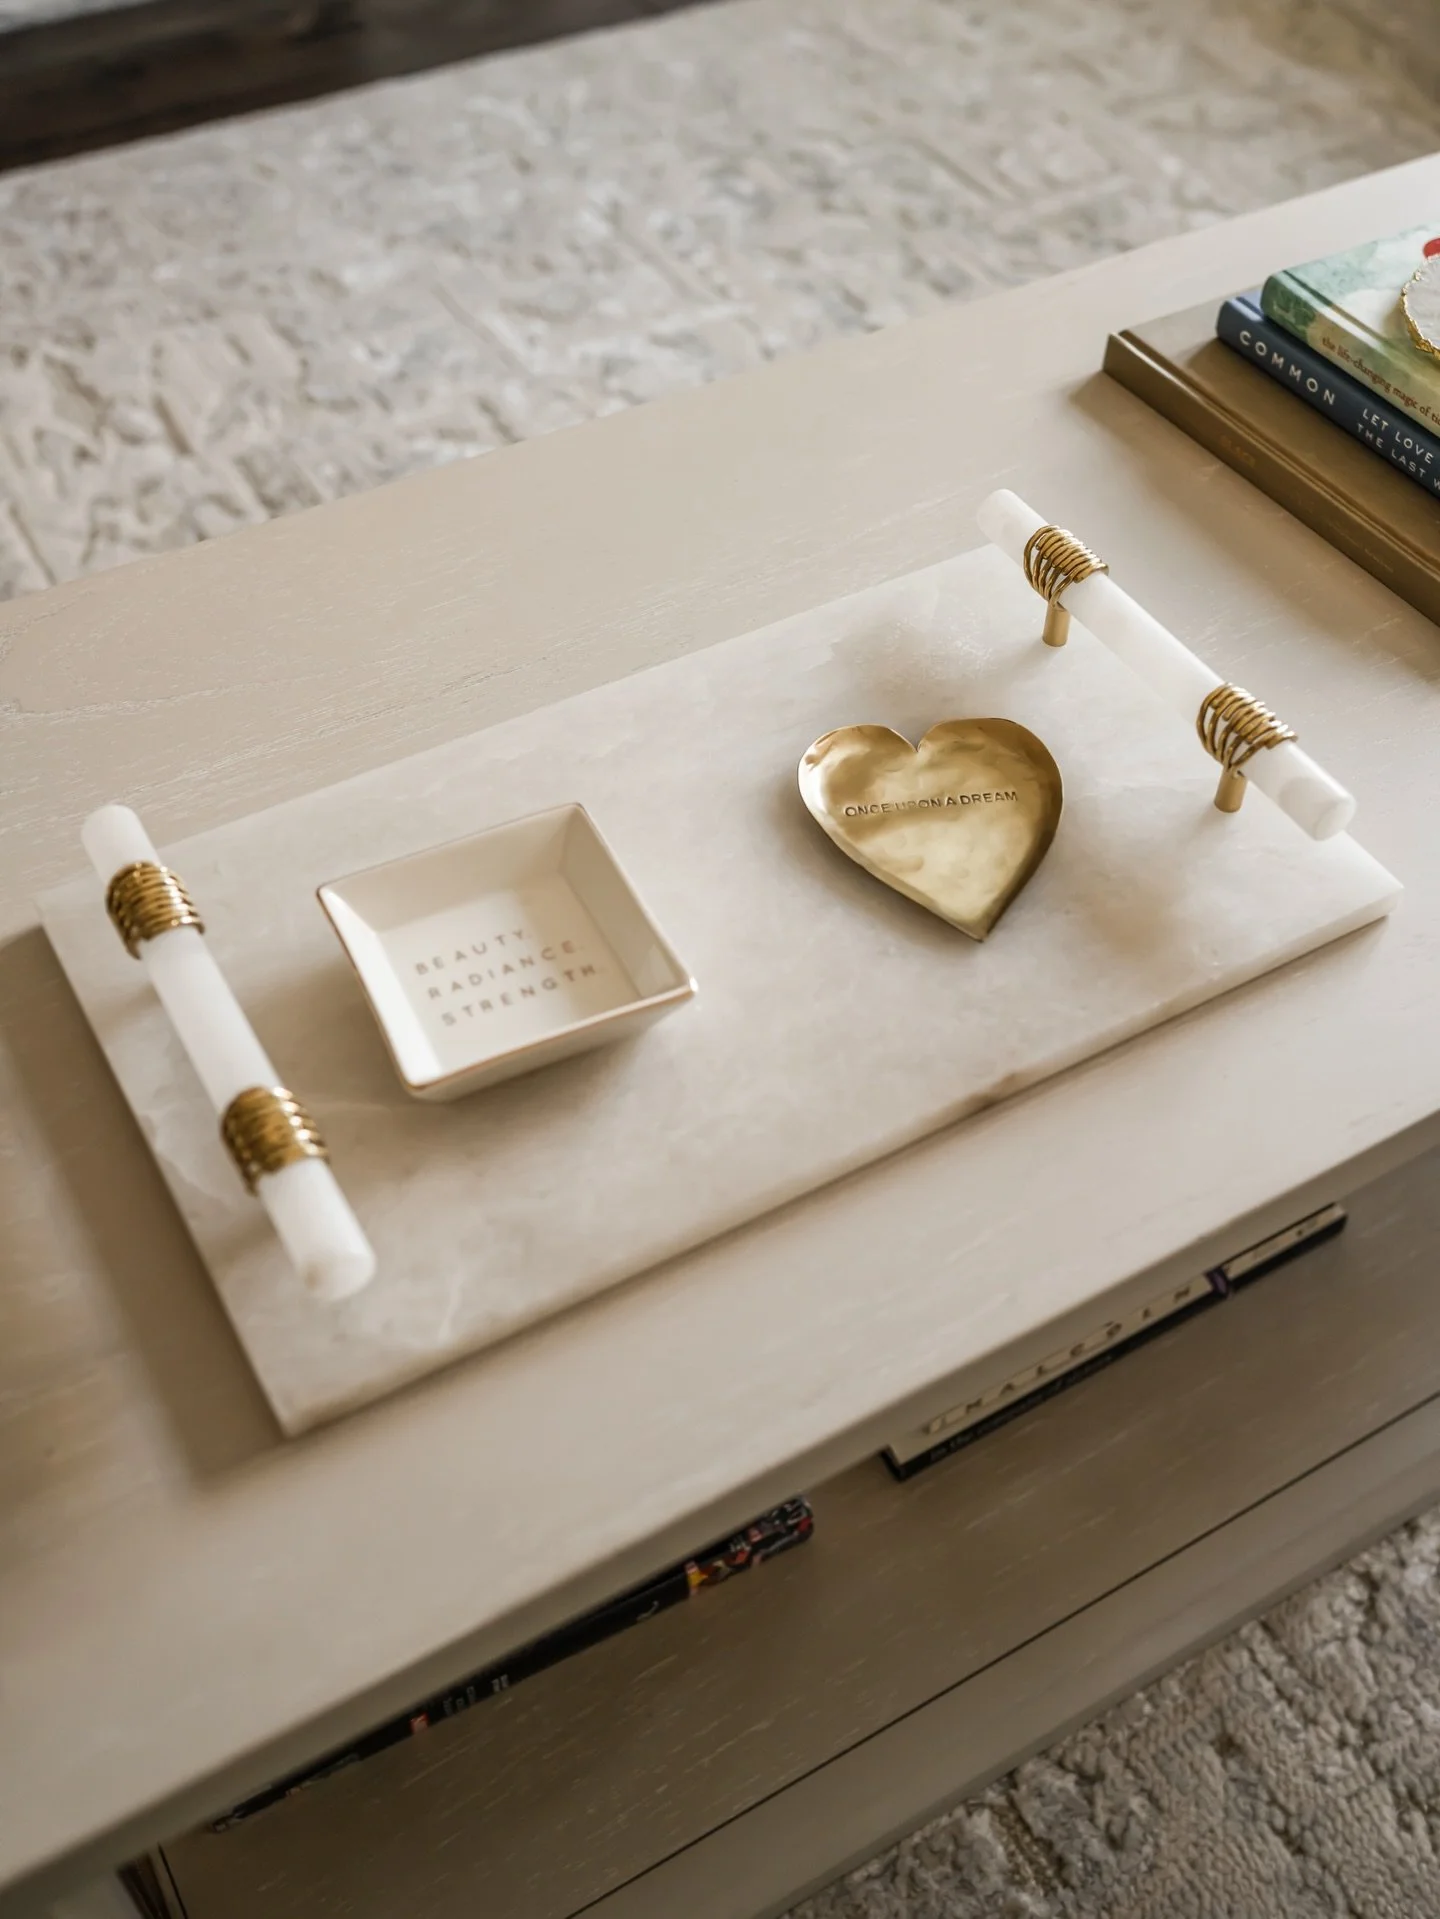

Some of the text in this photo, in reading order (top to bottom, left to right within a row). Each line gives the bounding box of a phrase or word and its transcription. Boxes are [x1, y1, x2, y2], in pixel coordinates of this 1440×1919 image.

[1239, 330, 1335, 406] COMMON
[1322, 336, 1335, 351] the
[1393, 387, 1418, 409] magic
[1419, 405, 1432, 417] of
[1357, 423, 1383, 449] THE
[1391, 449, 1427, 479] LAST
[1362, 408, 1434, 465] LET LOVE
[844, 791, 1018, 817] ONCE UPON A DREAM
